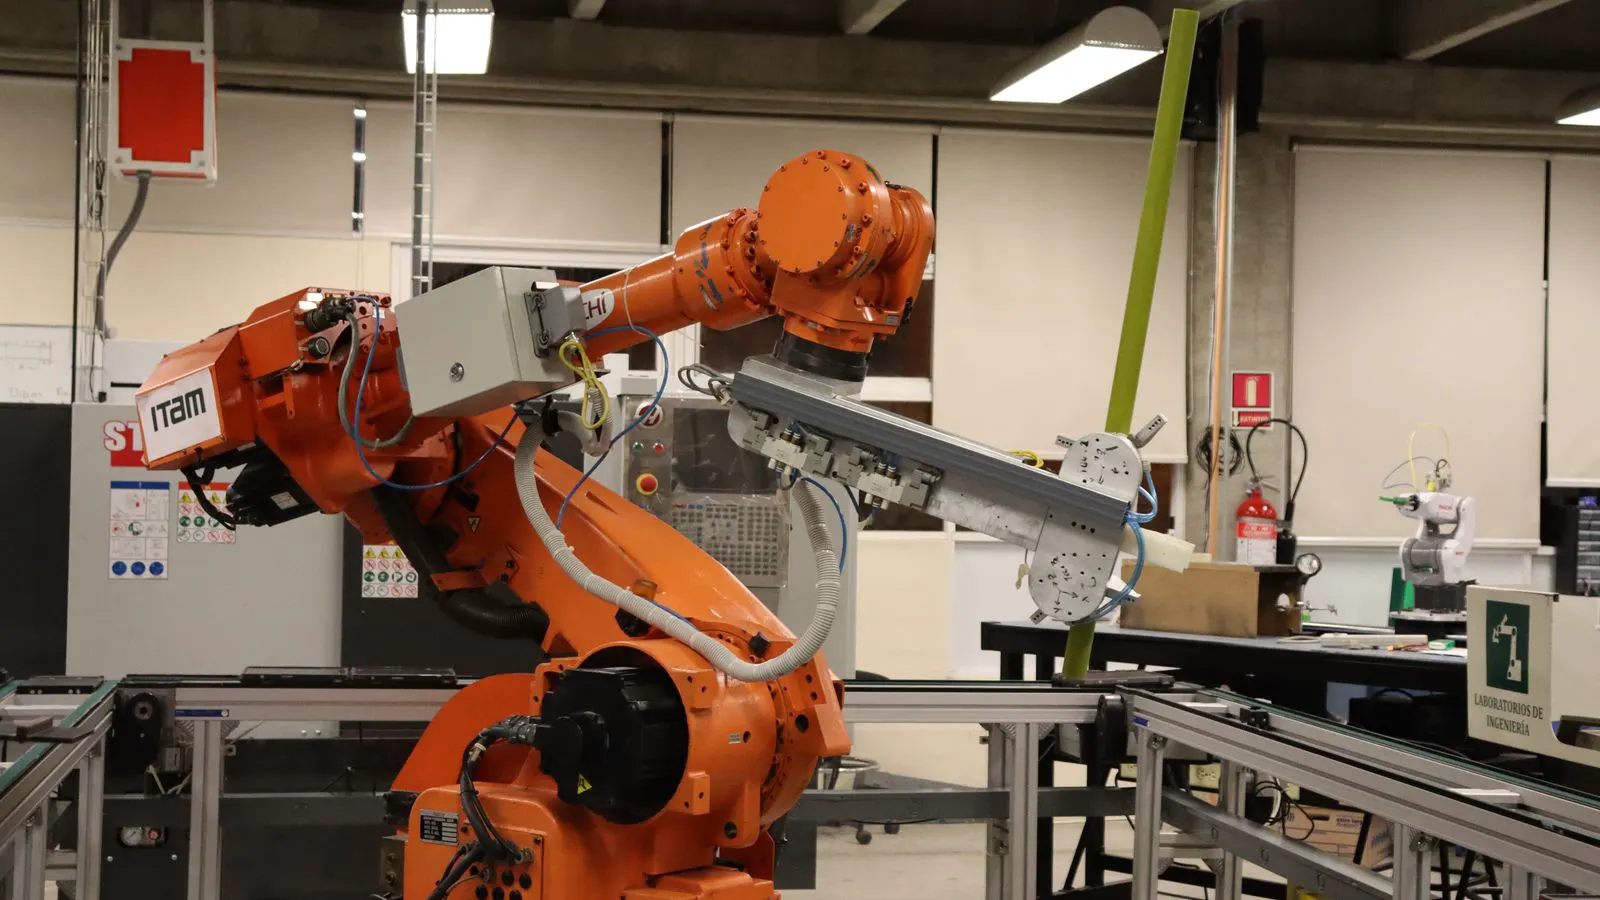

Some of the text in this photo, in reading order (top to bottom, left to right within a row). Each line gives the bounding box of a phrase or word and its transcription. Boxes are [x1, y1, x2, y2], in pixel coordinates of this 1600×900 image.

[1474, 693, 1544, 720] LABORATORIOS DE
[1486, 714, 1530, 737] INGENIERÍA
